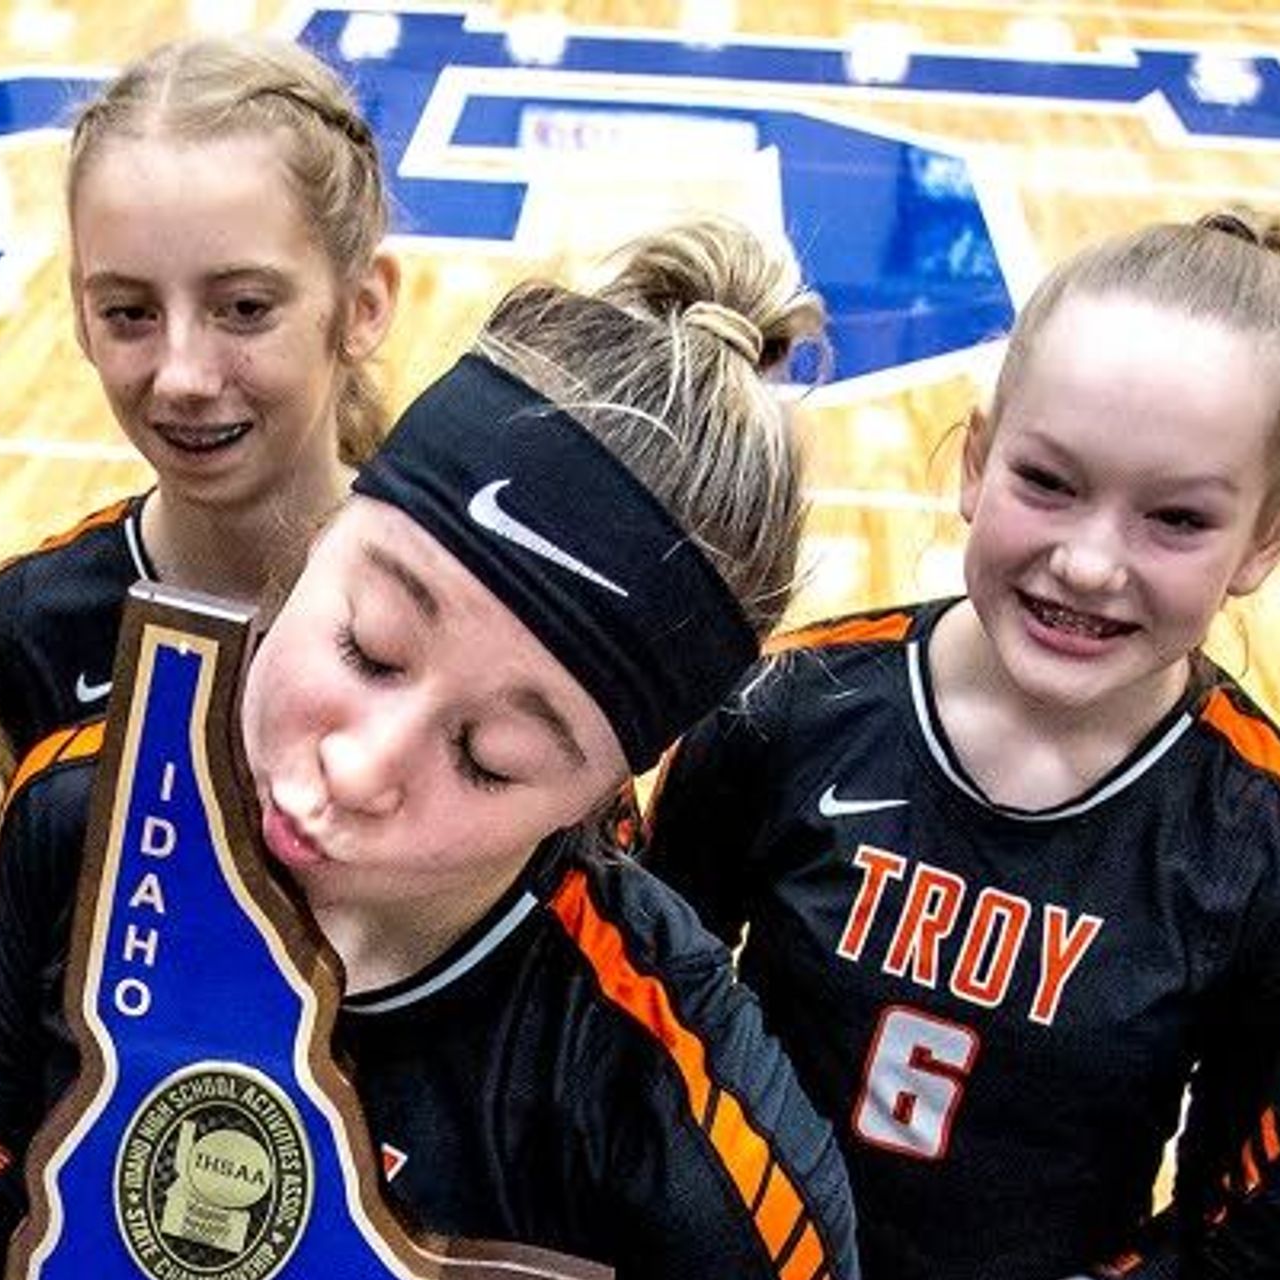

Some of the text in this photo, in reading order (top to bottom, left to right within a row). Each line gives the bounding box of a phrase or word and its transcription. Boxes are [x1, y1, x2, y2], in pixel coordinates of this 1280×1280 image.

[114, 761, 177, 1016] IDAHO
[835, 844, 1104, 1026] TROY
[169, 1075, 239, 1110] SCHOOL
[240, 1085, 303, 1170] ACTIVITIES
[851, 1003, 981, 1160] 6
[194, 1152, 267, 1187] IHSAA
[125, 1207, 157, 1260] STATE
